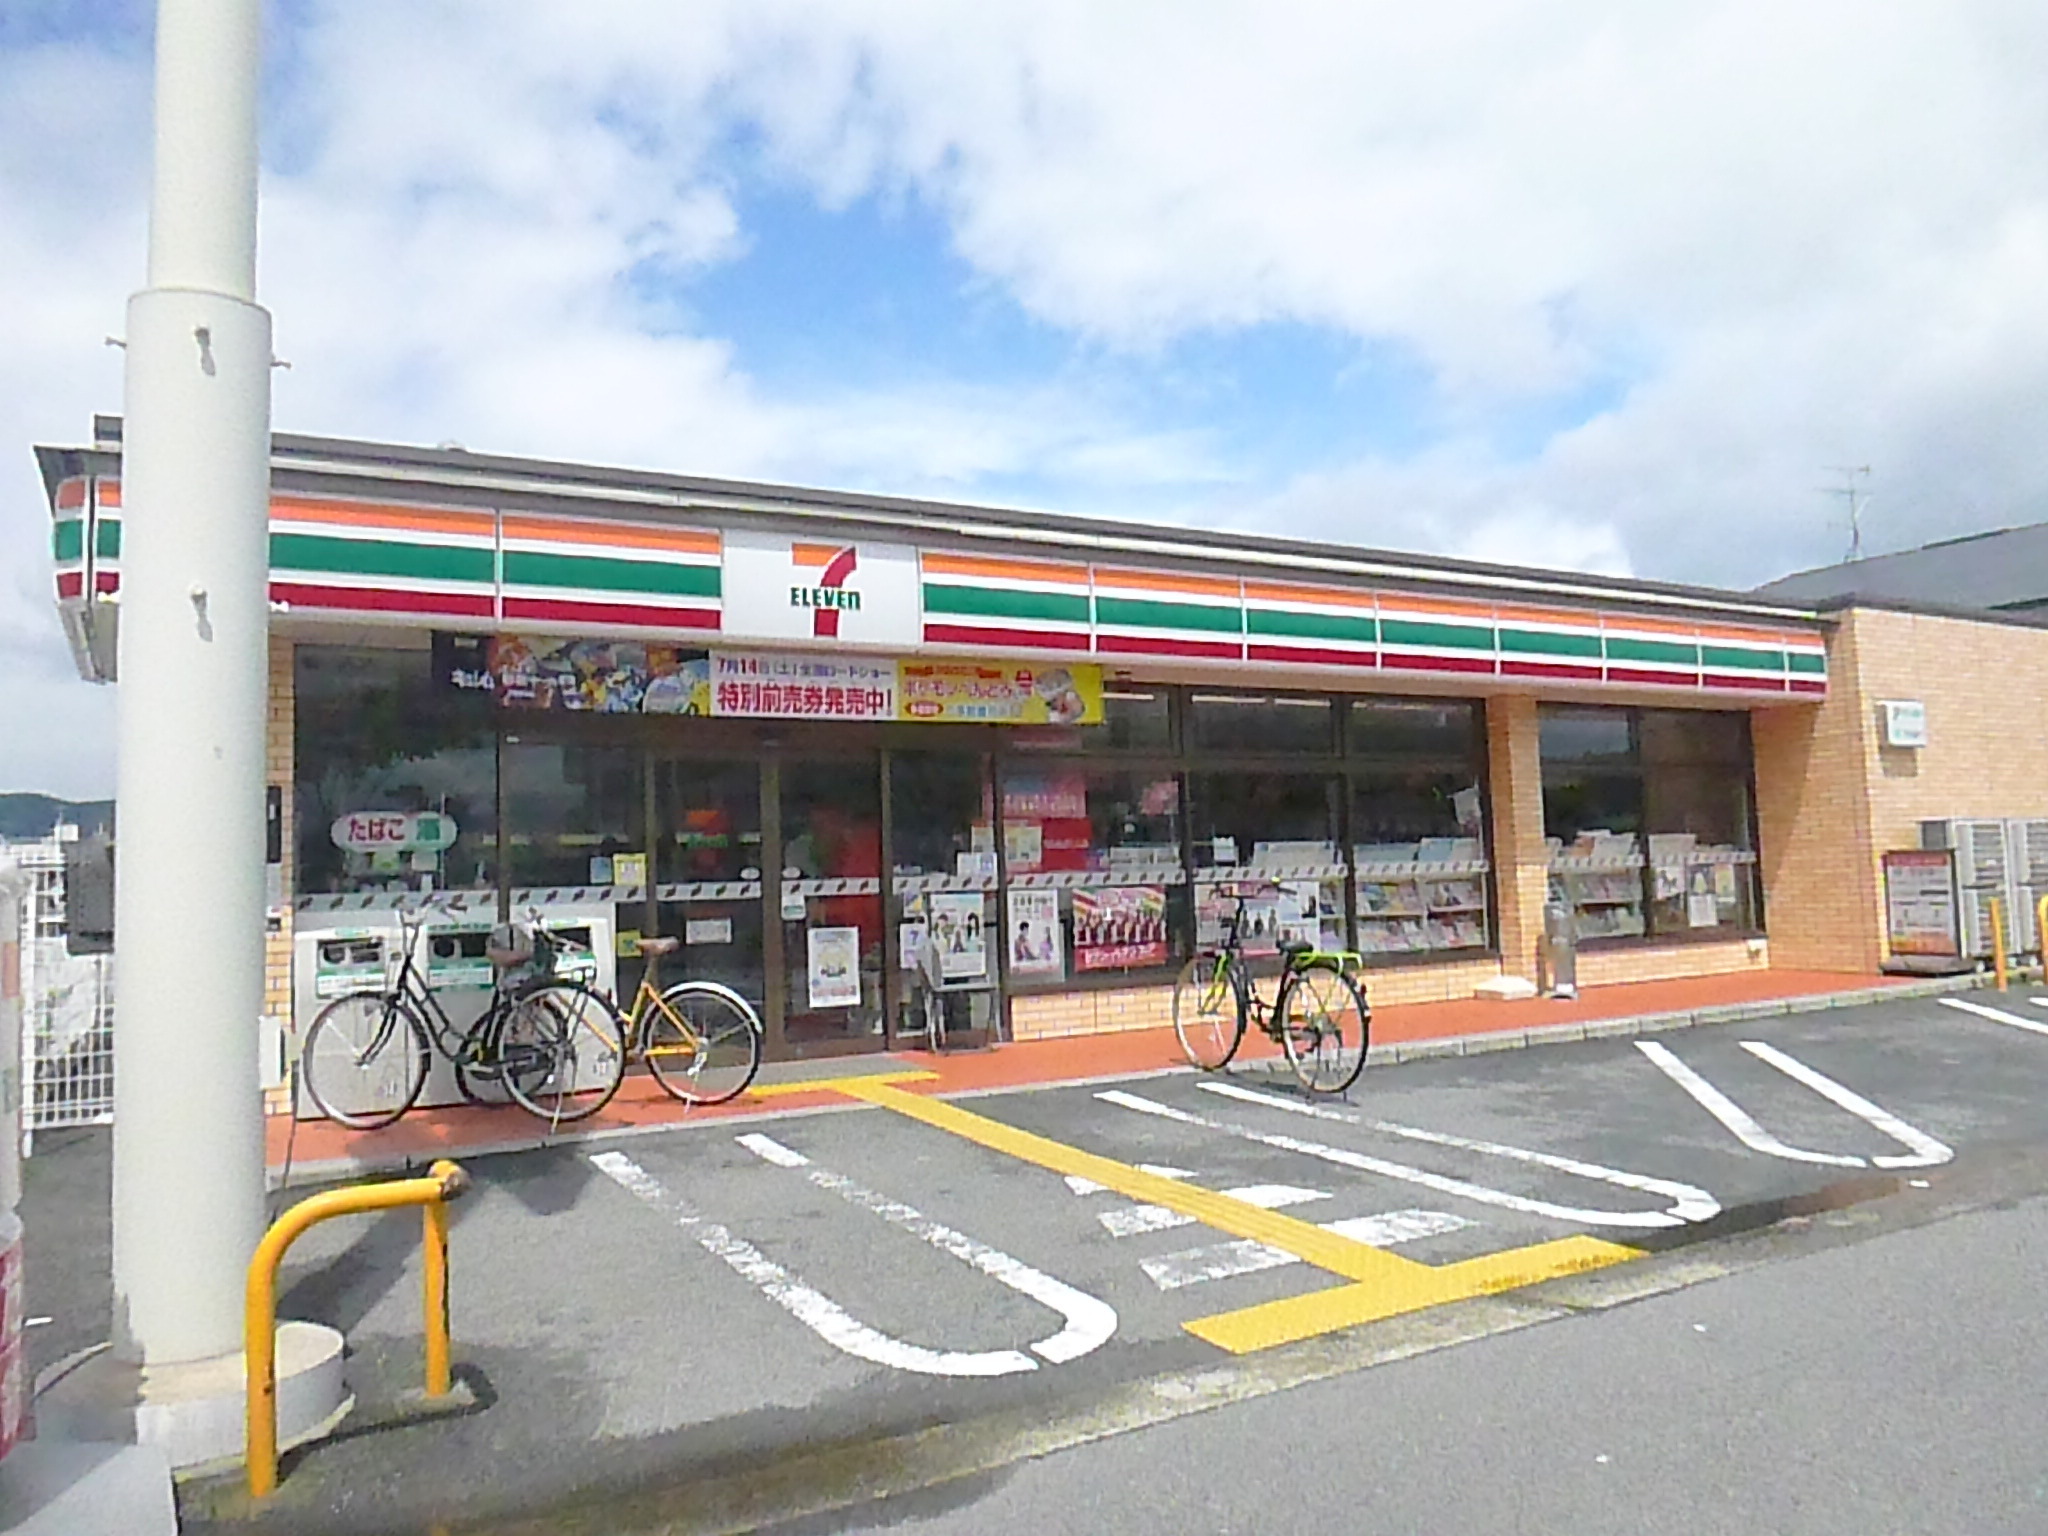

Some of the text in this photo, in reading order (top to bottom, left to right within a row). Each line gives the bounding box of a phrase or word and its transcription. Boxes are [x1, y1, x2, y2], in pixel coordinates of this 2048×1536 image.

[792, 543, 857, 636] 7
[348, 818, 404, 842] たばこ
